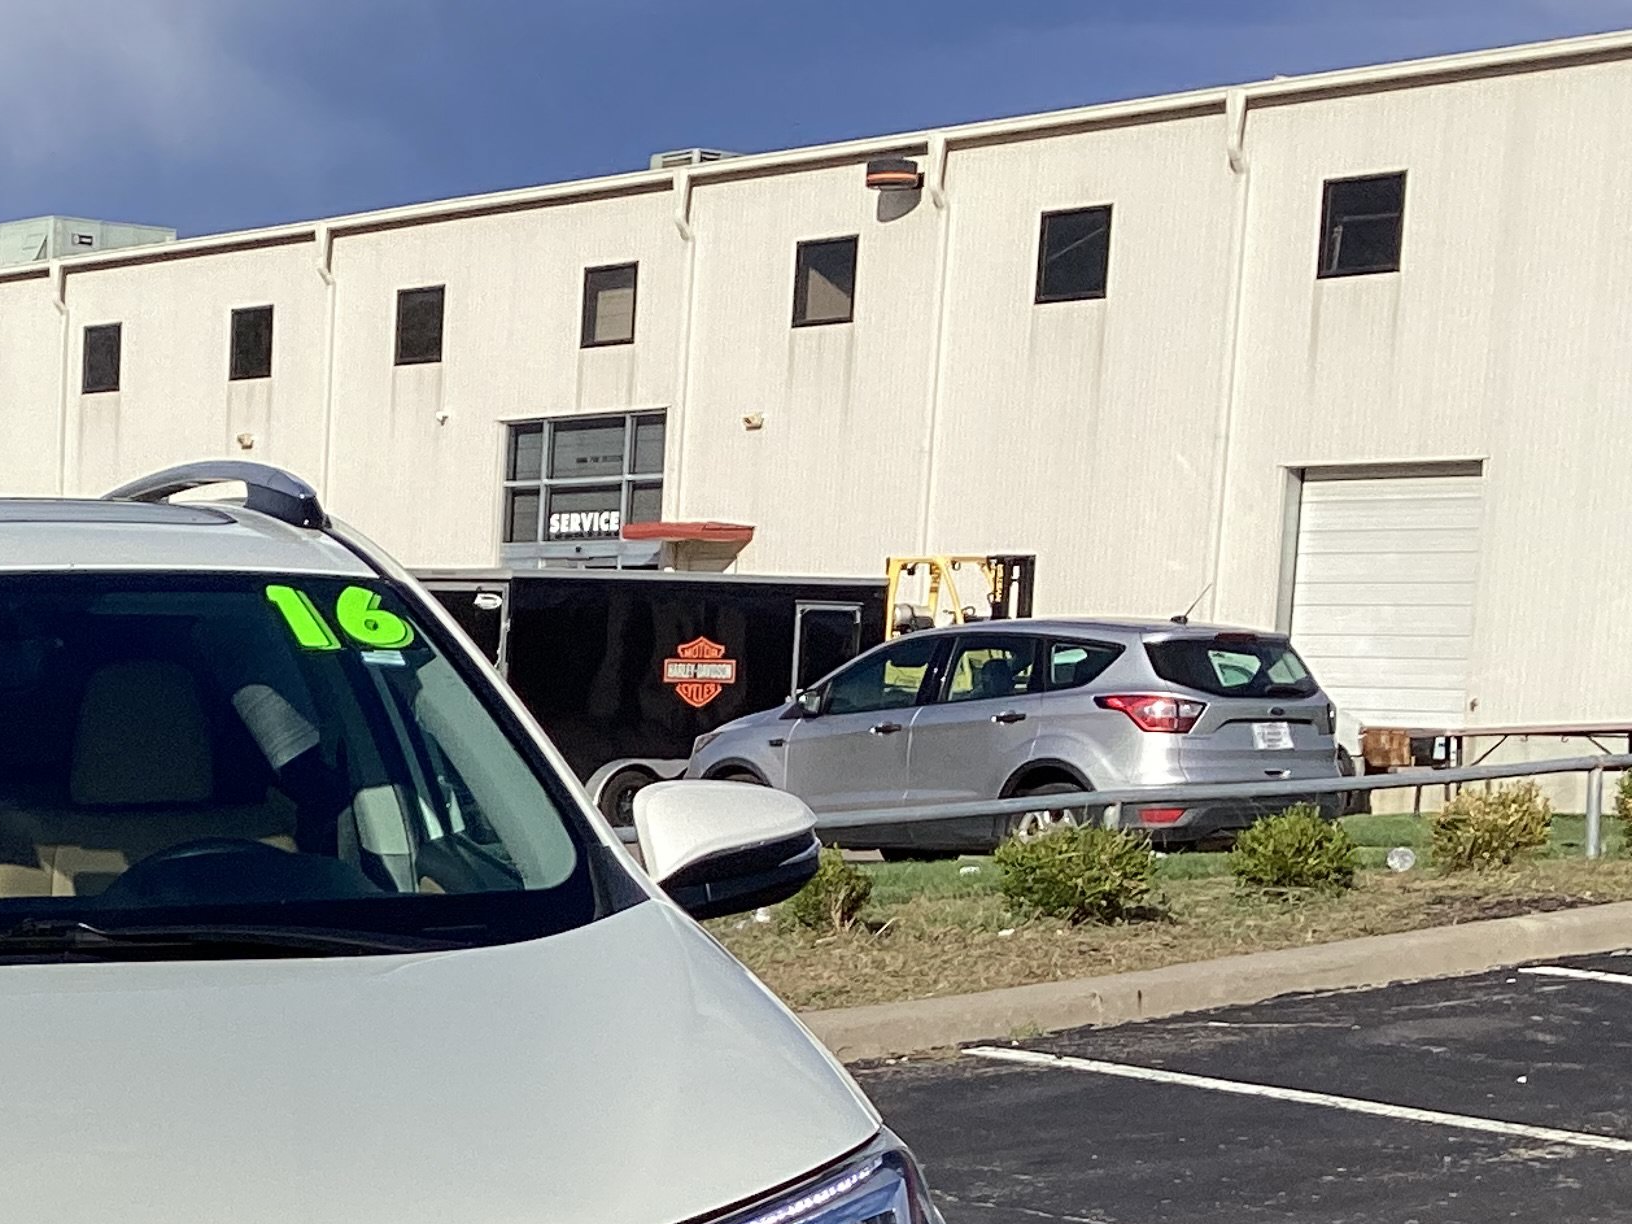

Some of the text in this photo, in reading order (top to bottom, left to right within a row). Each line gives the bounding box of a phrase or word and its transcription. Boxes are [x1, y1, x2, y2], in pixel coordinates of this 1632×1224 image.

[549, 510, 620, 533] SERVICE
[265, 584, 415, 650] 16
[684, 641, 719, 658] MOTOR
